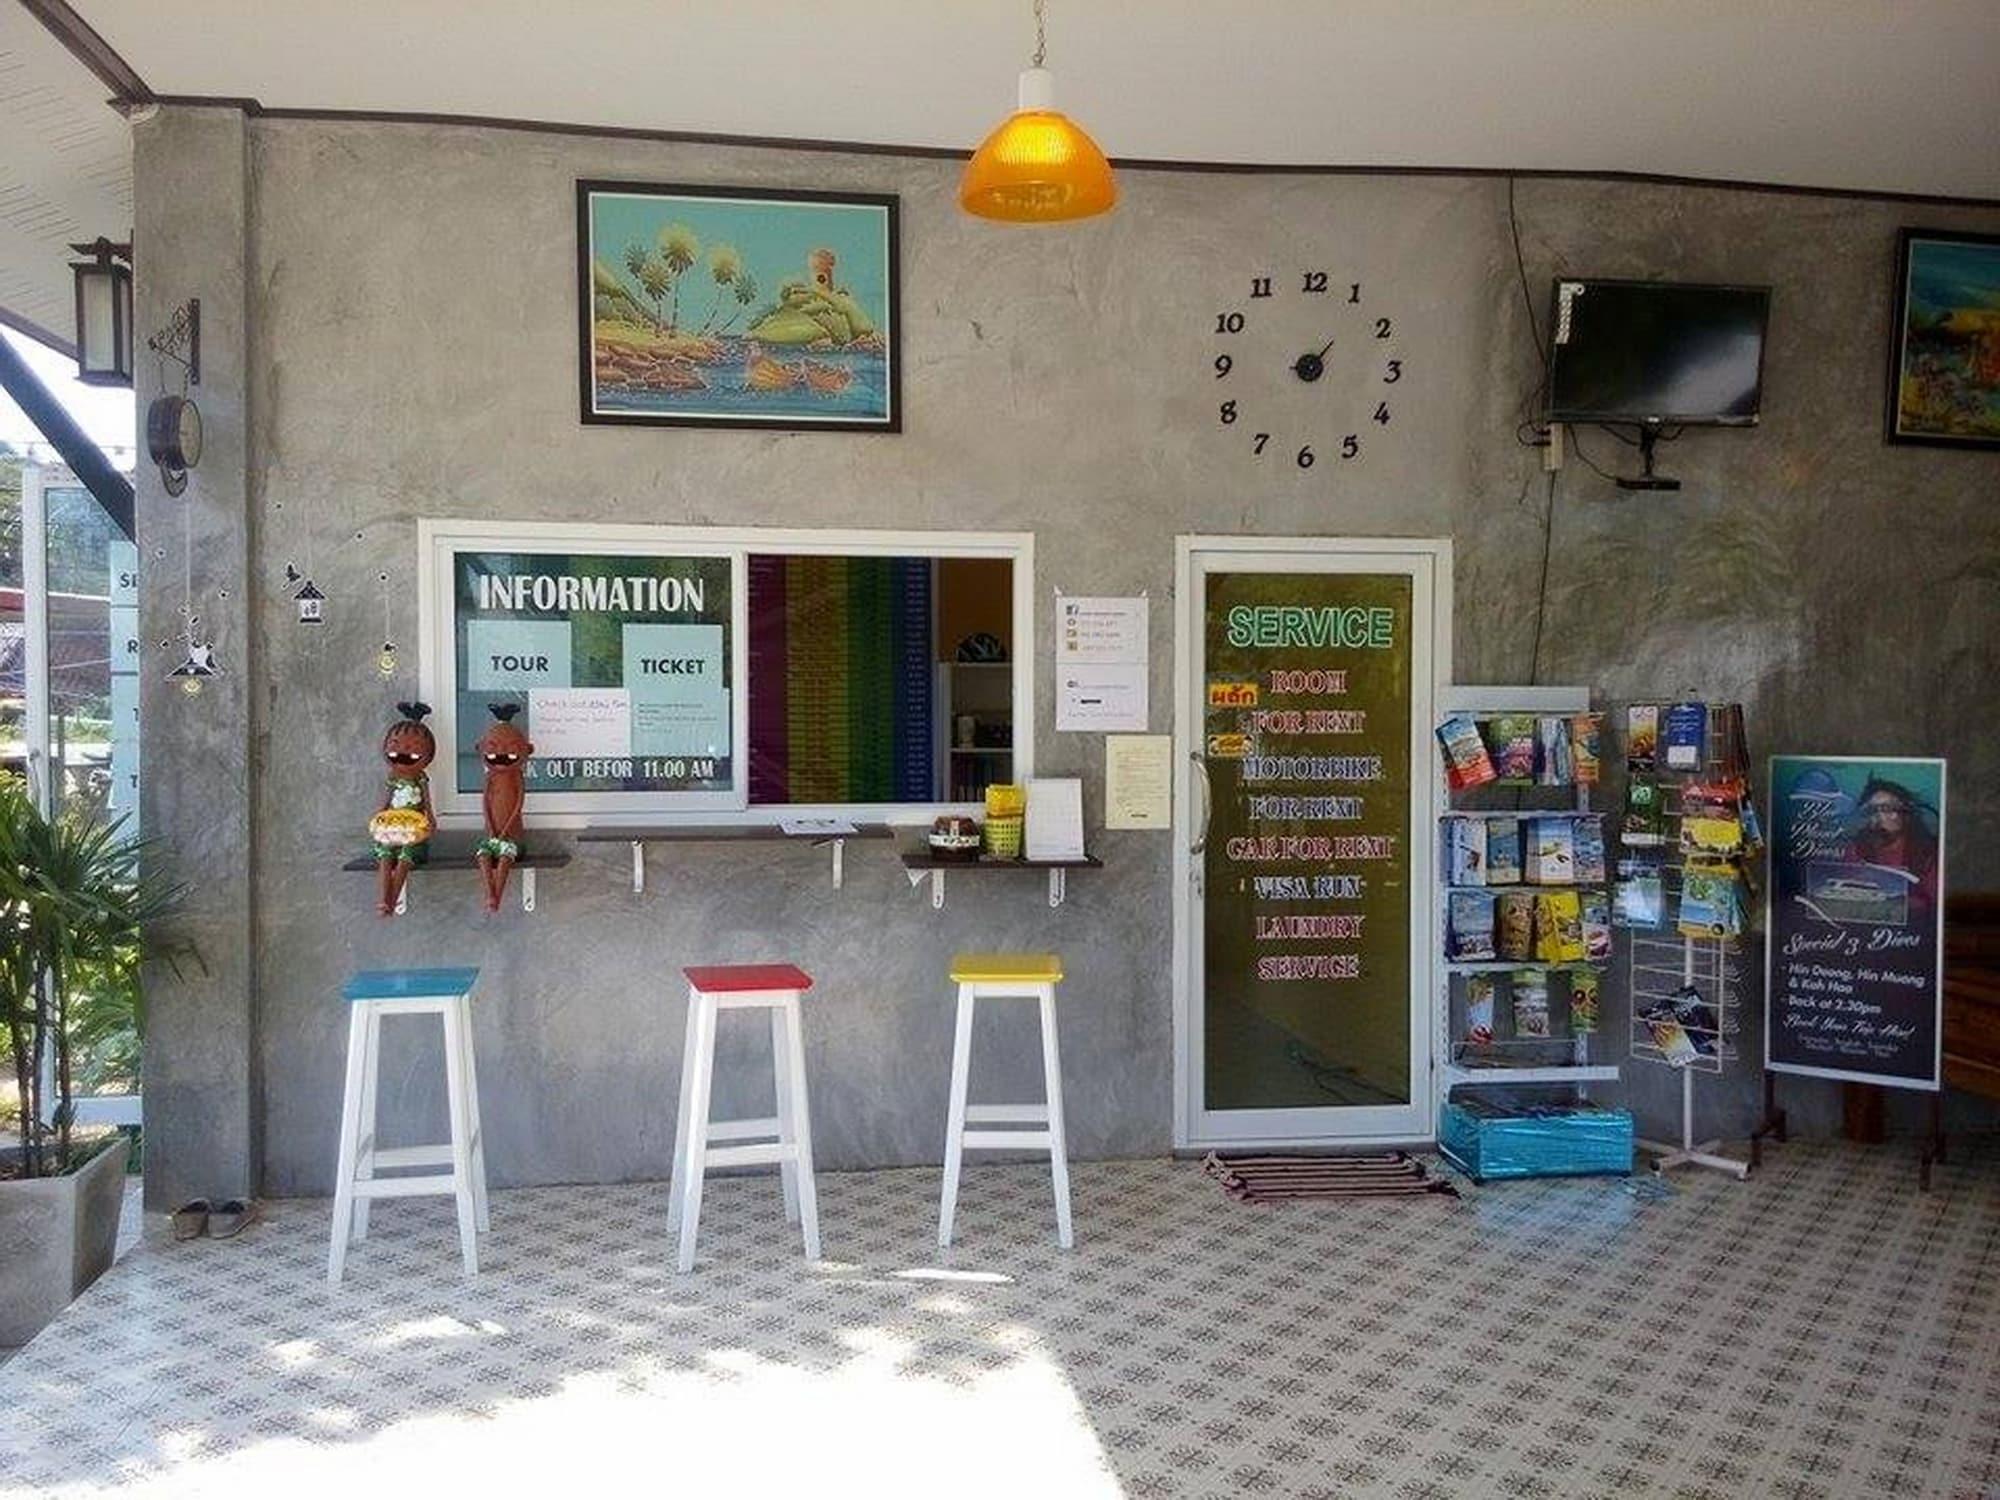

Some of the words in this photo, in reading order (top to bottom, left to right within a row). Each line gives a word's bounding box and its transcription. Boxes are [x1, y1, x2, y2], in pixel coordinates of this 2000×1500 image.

[1251, 278, 1272, 298] 11
[1302, 272, 1327, 292] 12
[1348, 283, 1360, 303] 1
[1215, 313, 1244, 333] 10
[1376, 318, 1391, 338] 2
[1215, 355, 1232, 379] 9
[1383, 361, 1402, 383] 3
[1220, 400, 1237, 424] 8
[1374, 402, 1390, 424] 4
[1254, 434, 1269, 454] 7
[1342, 435, 1358, 458] 5
[1298, 445, 1314, 468] 6
[480, 574, 704, 611] INFORMATION
[1228, 605, 1394, 648] SERVICE
[491, 655, 549, 672] TOUR
[641, 659, 705, 674] TICKET
[1270, 670, 1347, 693] ROOM
[1252, 710, 1302, 734] FOR
[1305, 710, 1366, 734] RENT
[546, 760, 577, 778] OUT
[583, 760, 633, 778] BEFOR
[643, 760, 686, 778] 11.00
[690, 760, 715, 778] AM
[1242, 756, 1383, 780] MOTORBIKE
[1249, 796, 1301, 820] FOR
[1304, 796, 1364, 820] RENT
[1226, 836, 1280, 860] CAR
[1281, 836, 1332, 860] FOR
[1335, 835, 1396, 859] RENT
[1254, 875, 1311, 899] VISA
[1314, 875, 1363, 899] RUN
[1256, 915, 1366, 939] LAUNDRY
[1783, 931, 1847, 956] Special
[1844, 937, 1860, 956] 3
[1257, 954, 1361, 980] SERVICE
